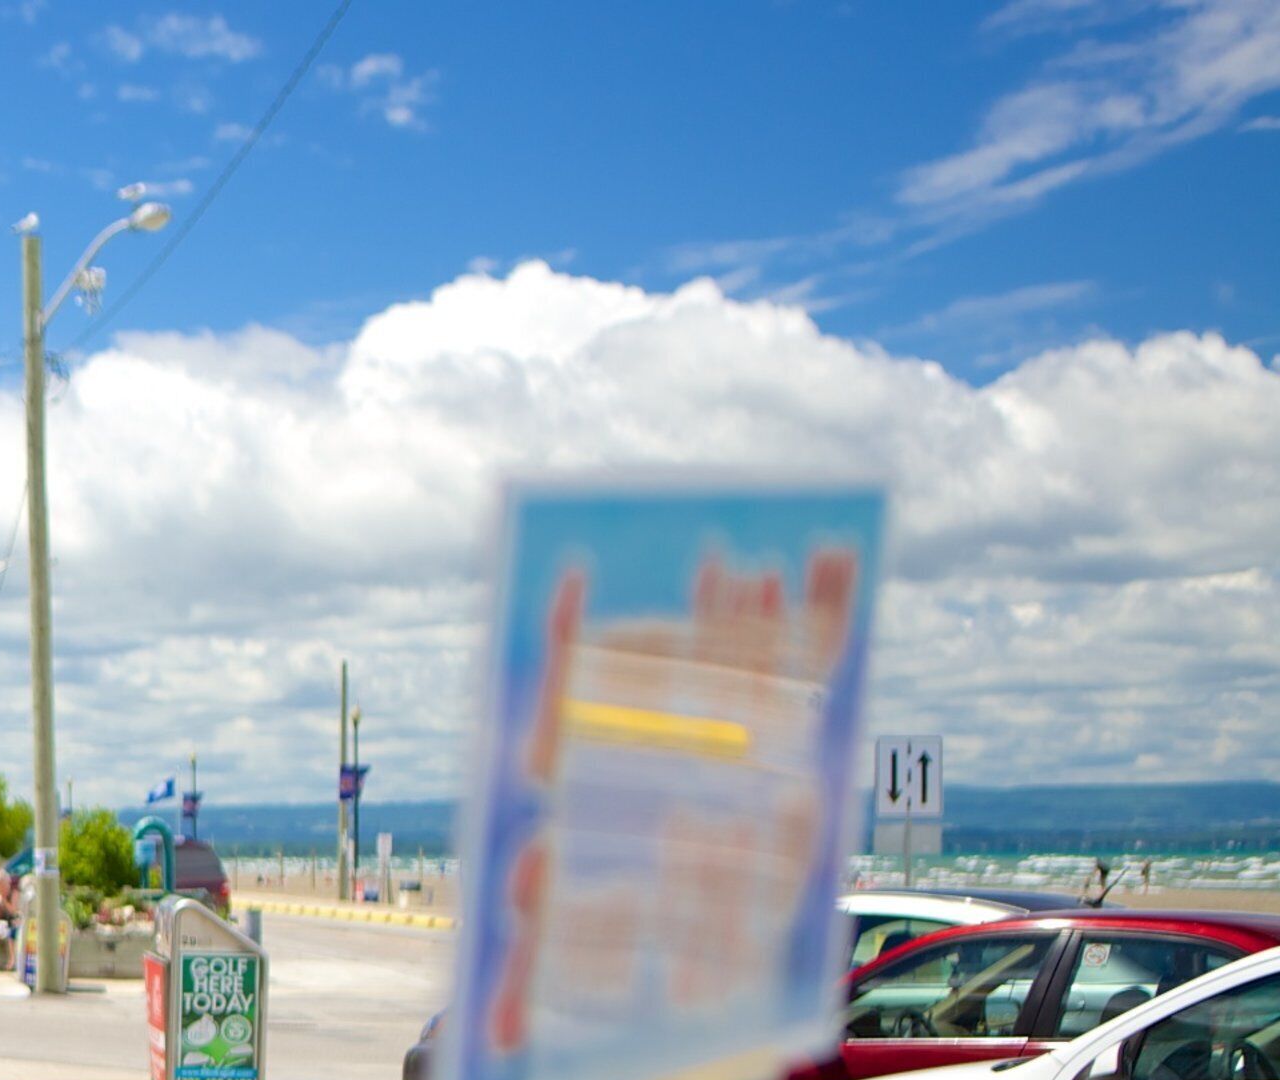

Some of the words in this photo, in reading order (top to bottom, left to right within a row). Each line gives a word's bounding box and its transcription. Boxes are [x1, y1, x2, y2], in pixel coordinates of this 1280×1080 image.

[190, 957, 248, 977] GOLF
[194, 974, 244, 993] HERE
[183, 992, 254, 1014] TODAY
